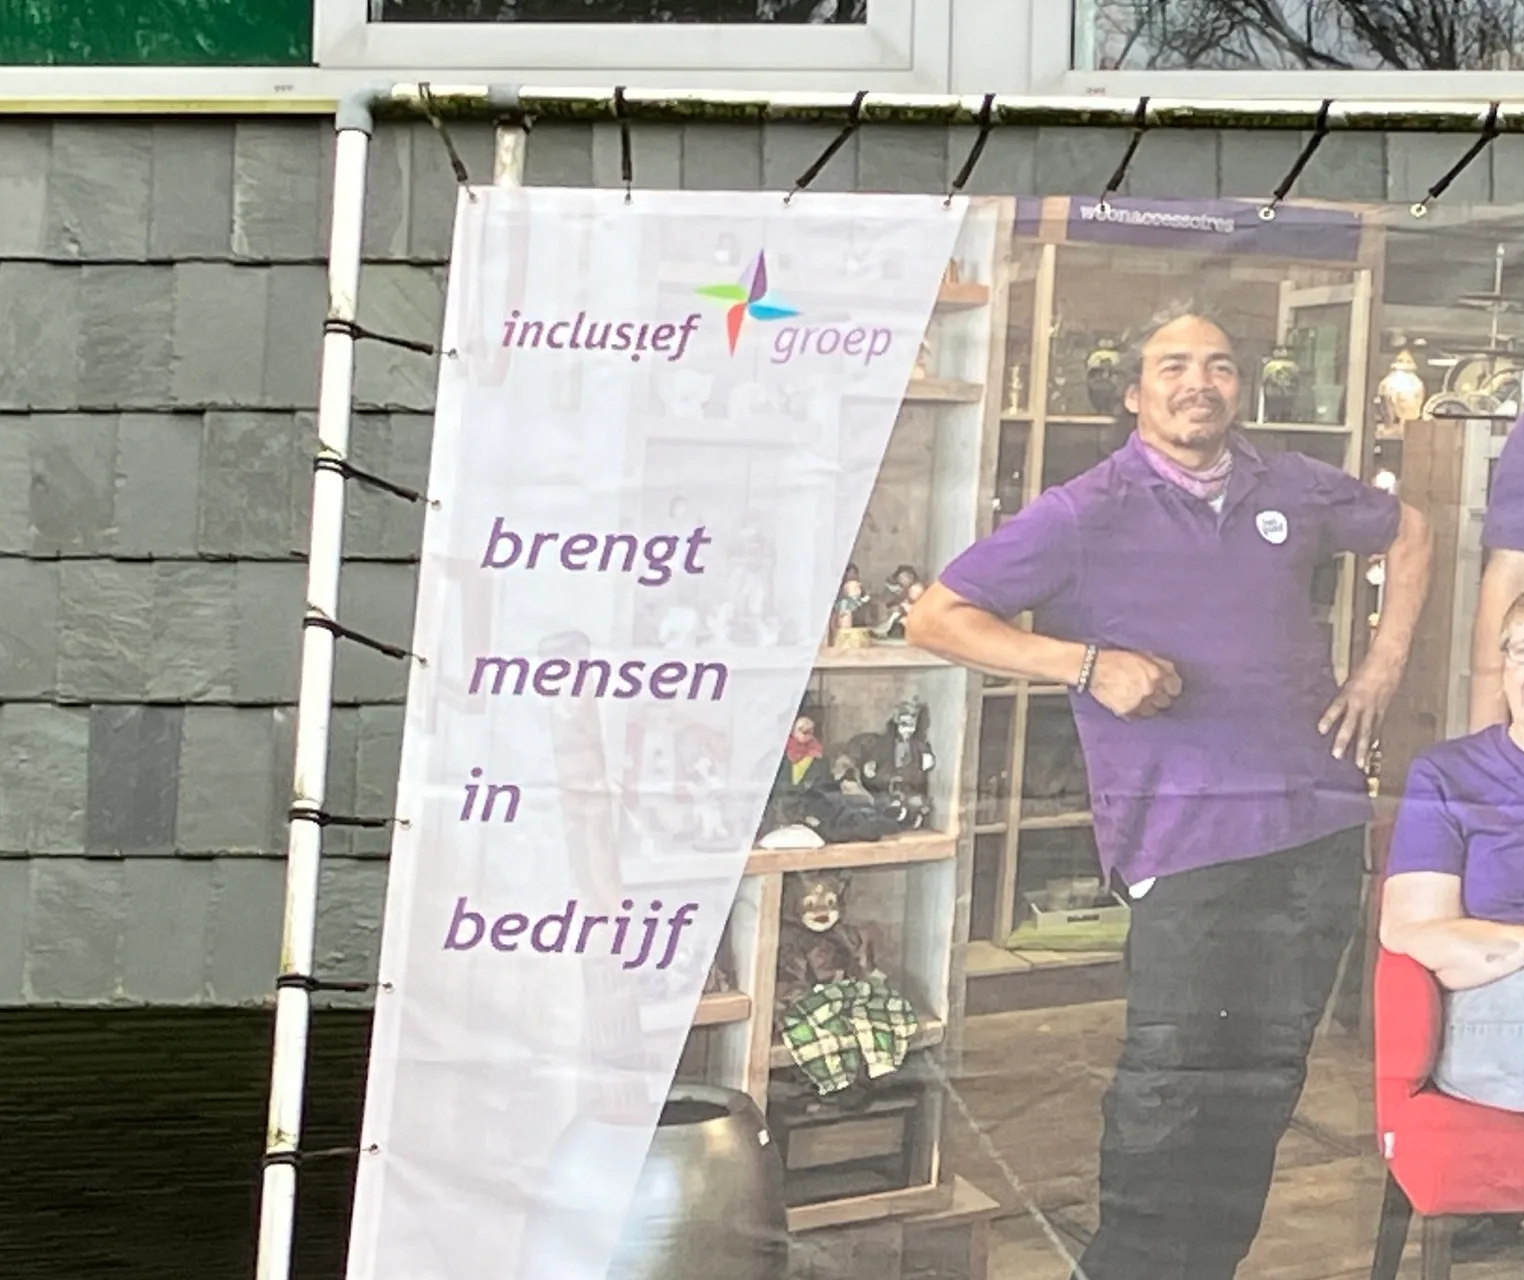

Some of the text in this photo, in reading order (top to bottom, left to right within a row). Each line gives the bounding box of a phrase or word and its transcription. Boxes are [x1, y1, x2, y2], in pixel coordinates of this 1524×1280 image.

[501, 310, 893, 366] inclusief groep
[481, 517, 712, 587] brengt
[468, 656, 728, 701] mensen
[459, 767, 522, 823] in
[443, 896, 699, 970] bedrijf
